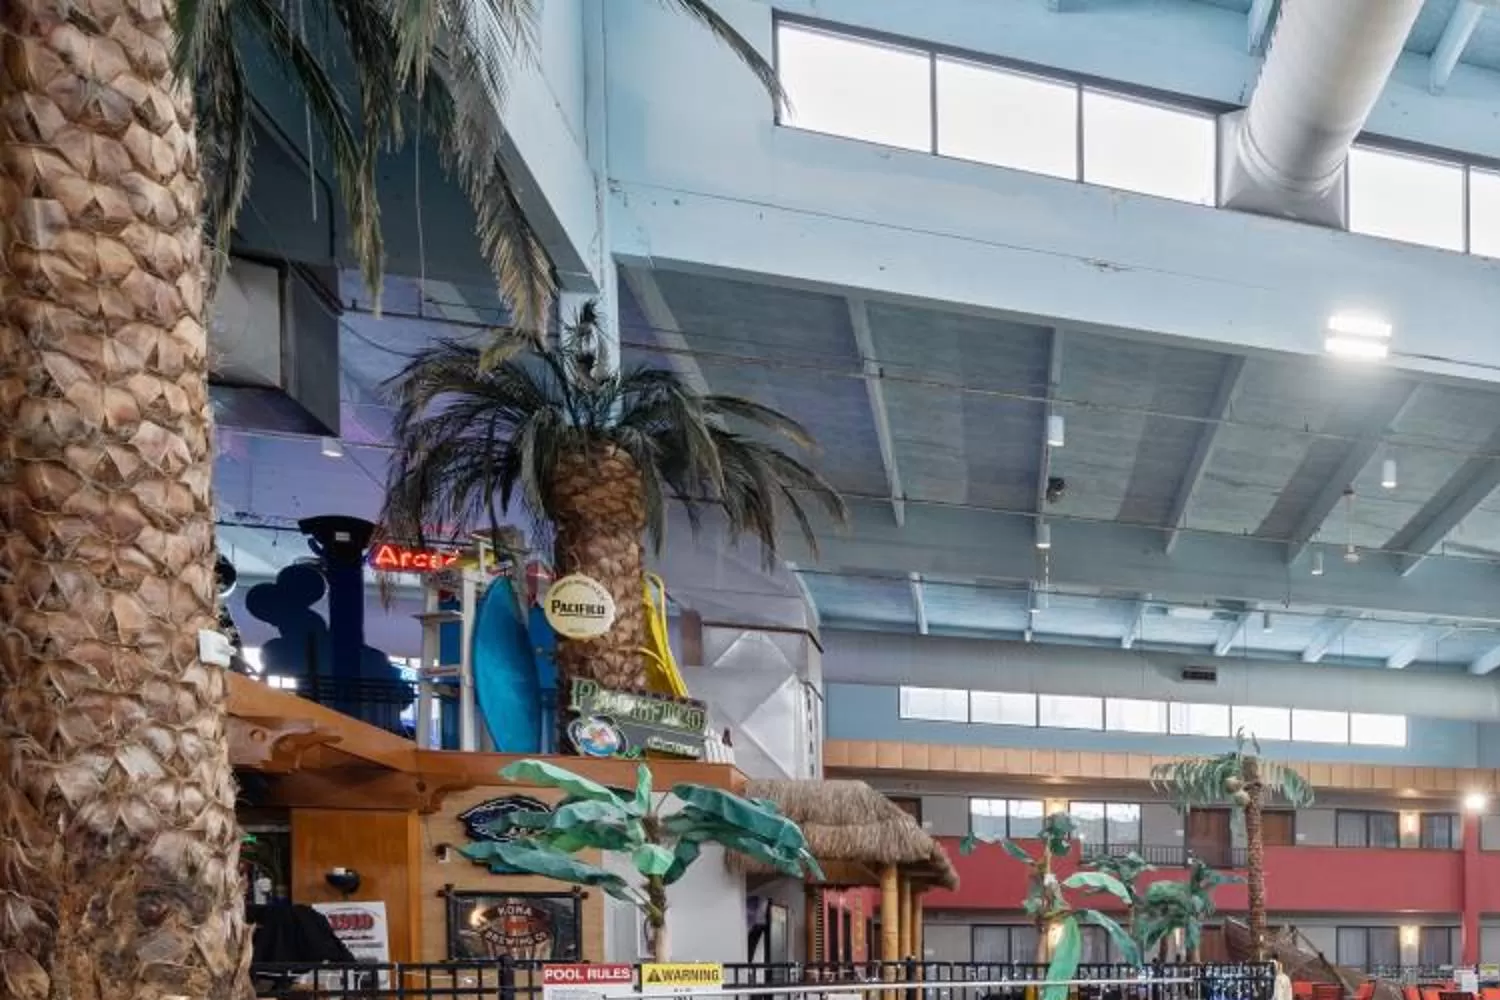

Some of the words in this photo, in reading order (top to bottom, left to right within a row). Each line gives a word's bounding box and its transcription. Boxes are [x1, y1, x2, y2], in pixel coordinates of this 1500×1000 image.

[544, 968, 584, 980] POOL
[587, 967, 631, 980] RULES
[661, 968, 719, 982] WARNING
